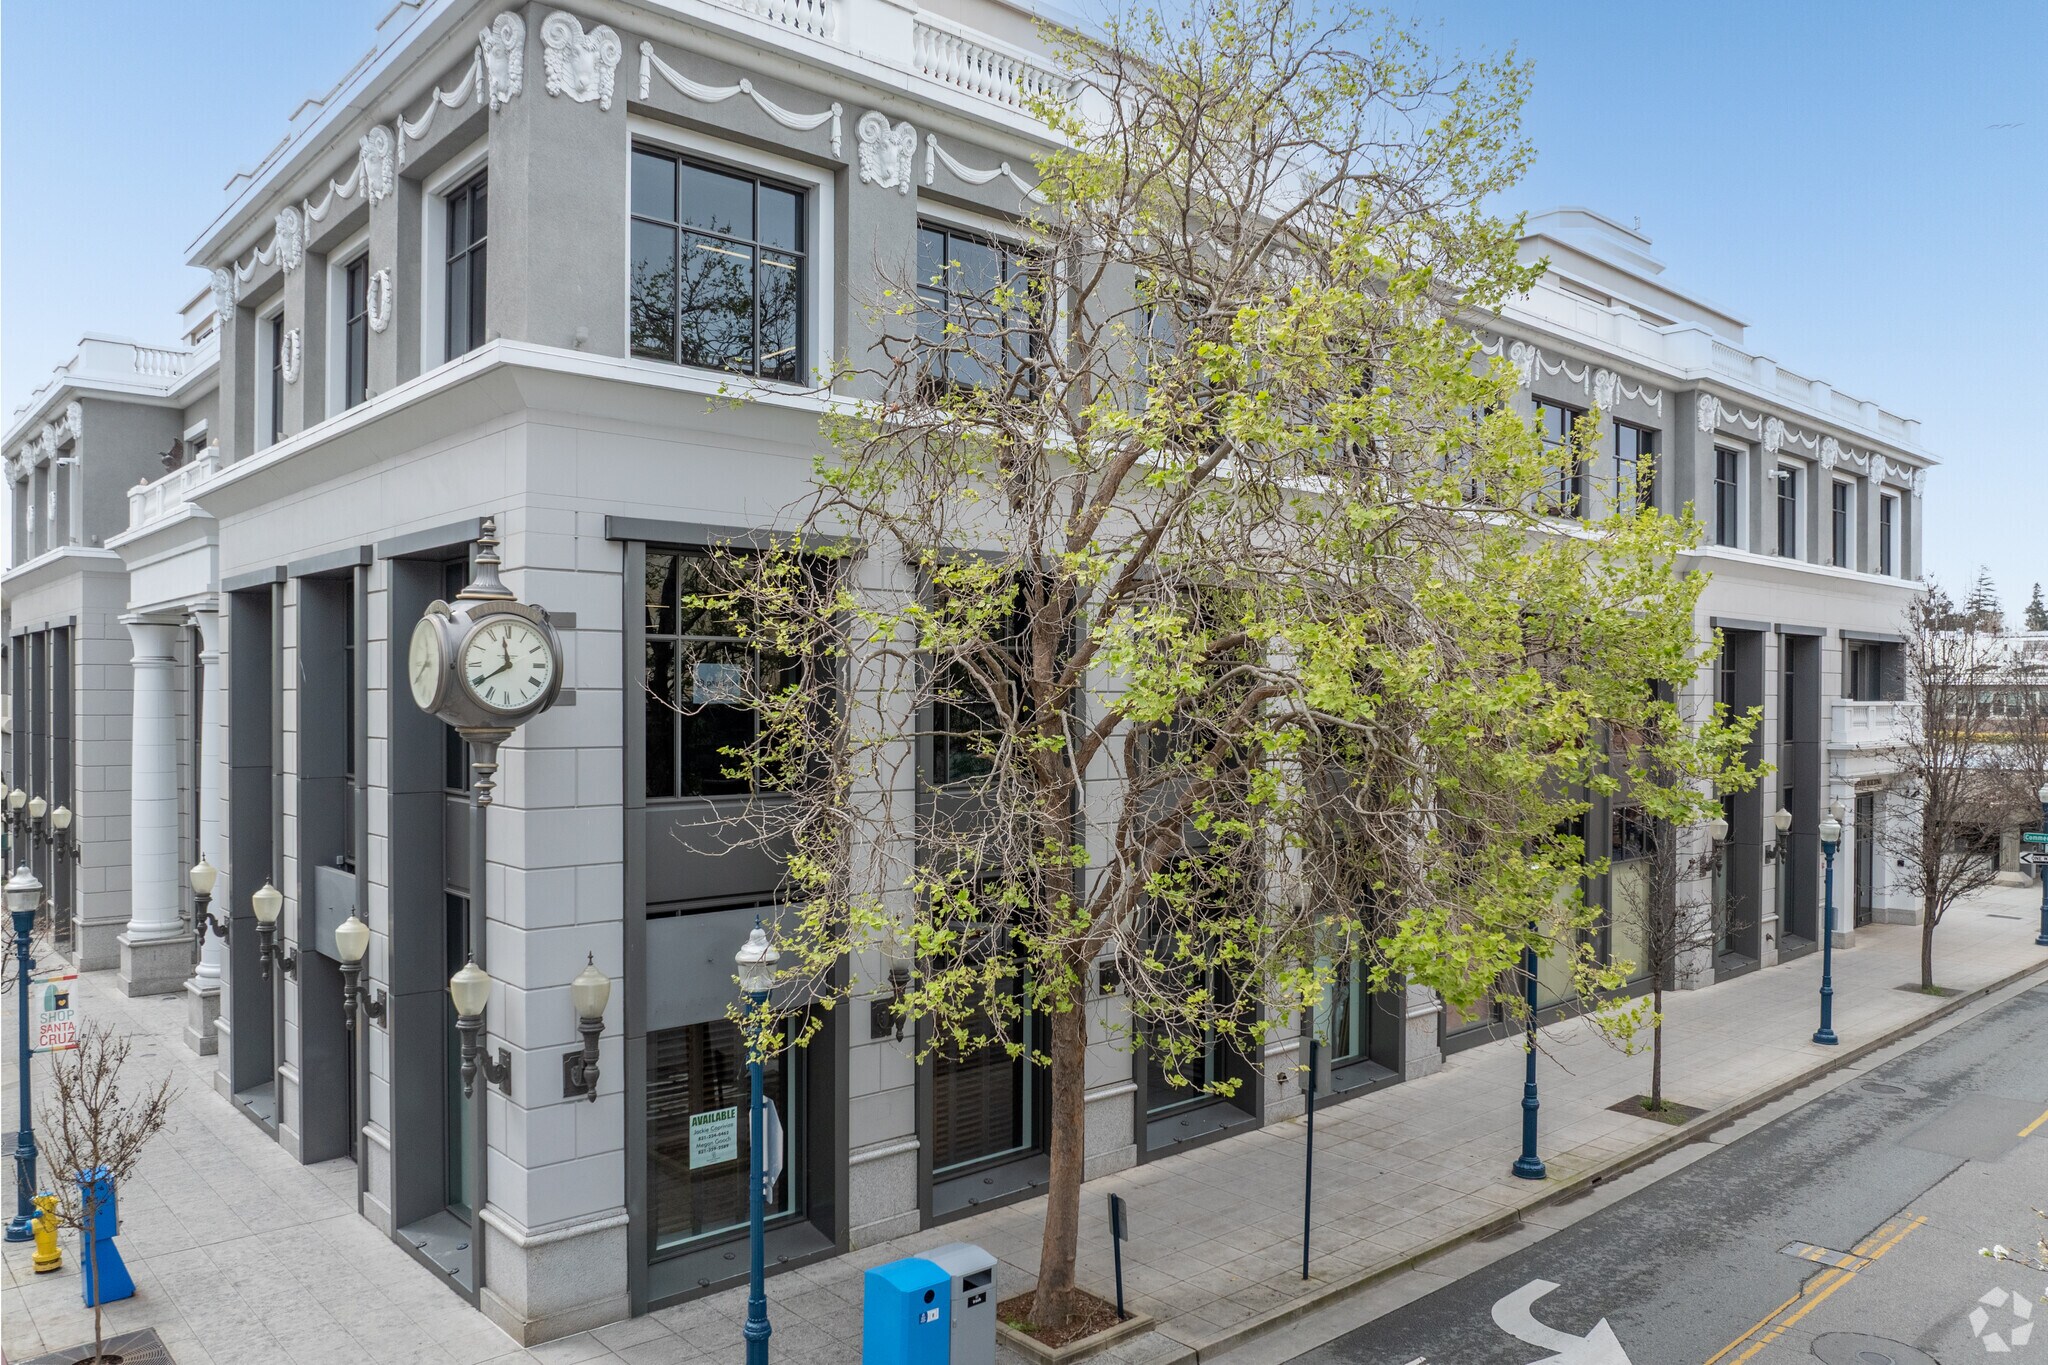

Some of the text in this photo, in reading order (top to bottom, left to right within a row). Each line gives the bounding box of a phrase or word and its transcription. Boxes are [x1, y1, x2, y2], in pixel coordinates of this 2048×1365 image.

[2025, 834, 2048, 842] Comme
[40, 1009, 75, 1024] SHOP
[40, 1021, 75, 1035] SANTA
[40, 1032, 75, 1046] CRUZ
[692, 1109, 735, 1126] AVAILABLE
